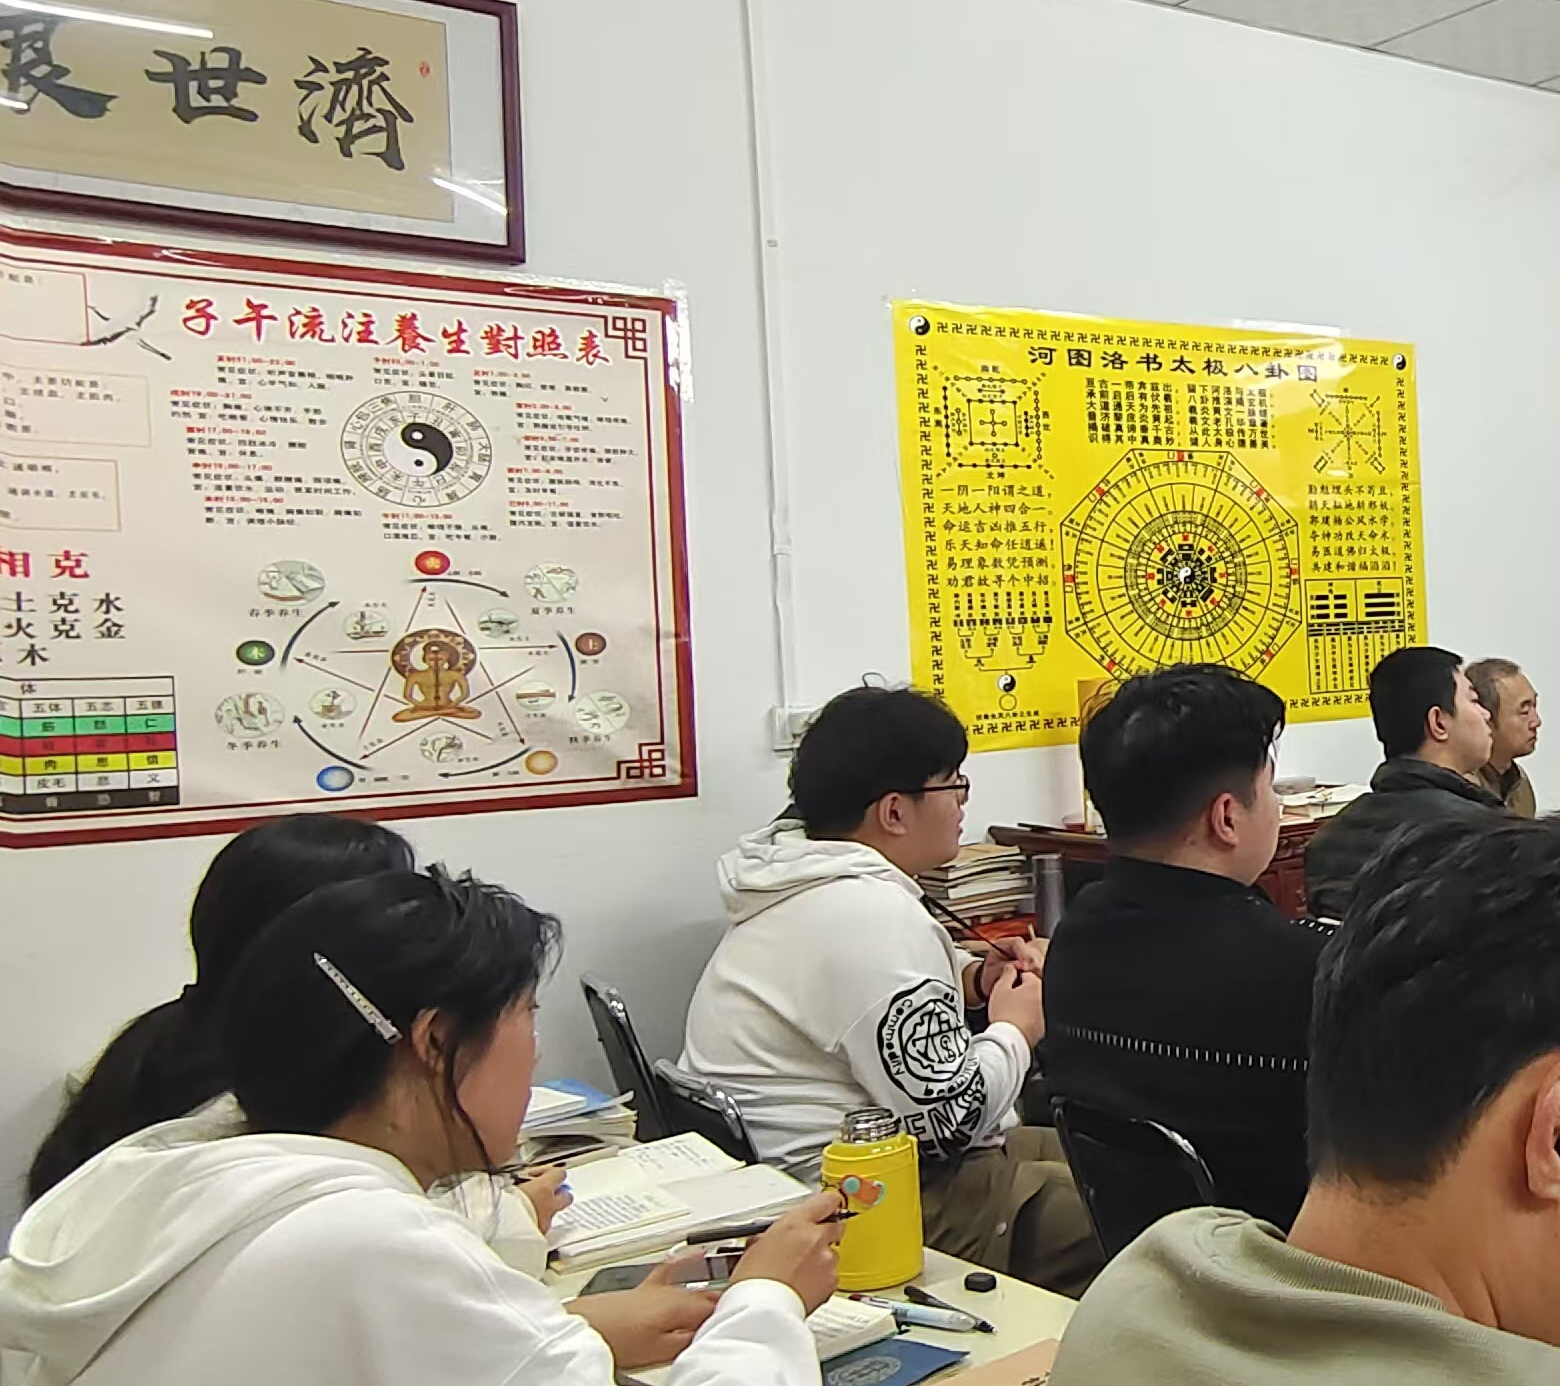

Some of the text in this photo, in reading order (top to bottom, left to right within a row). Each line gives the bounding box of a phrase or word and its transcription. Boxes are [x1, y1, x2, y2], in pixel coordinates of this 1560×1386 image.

[179, 297, 611, 369] 子午流注養生對照表
[1028, 345, 1318, 383] 河图洛书太极八卦图
[0, 590, 125, 616] 土克水
[4, 616, 127, 640] 火克金
